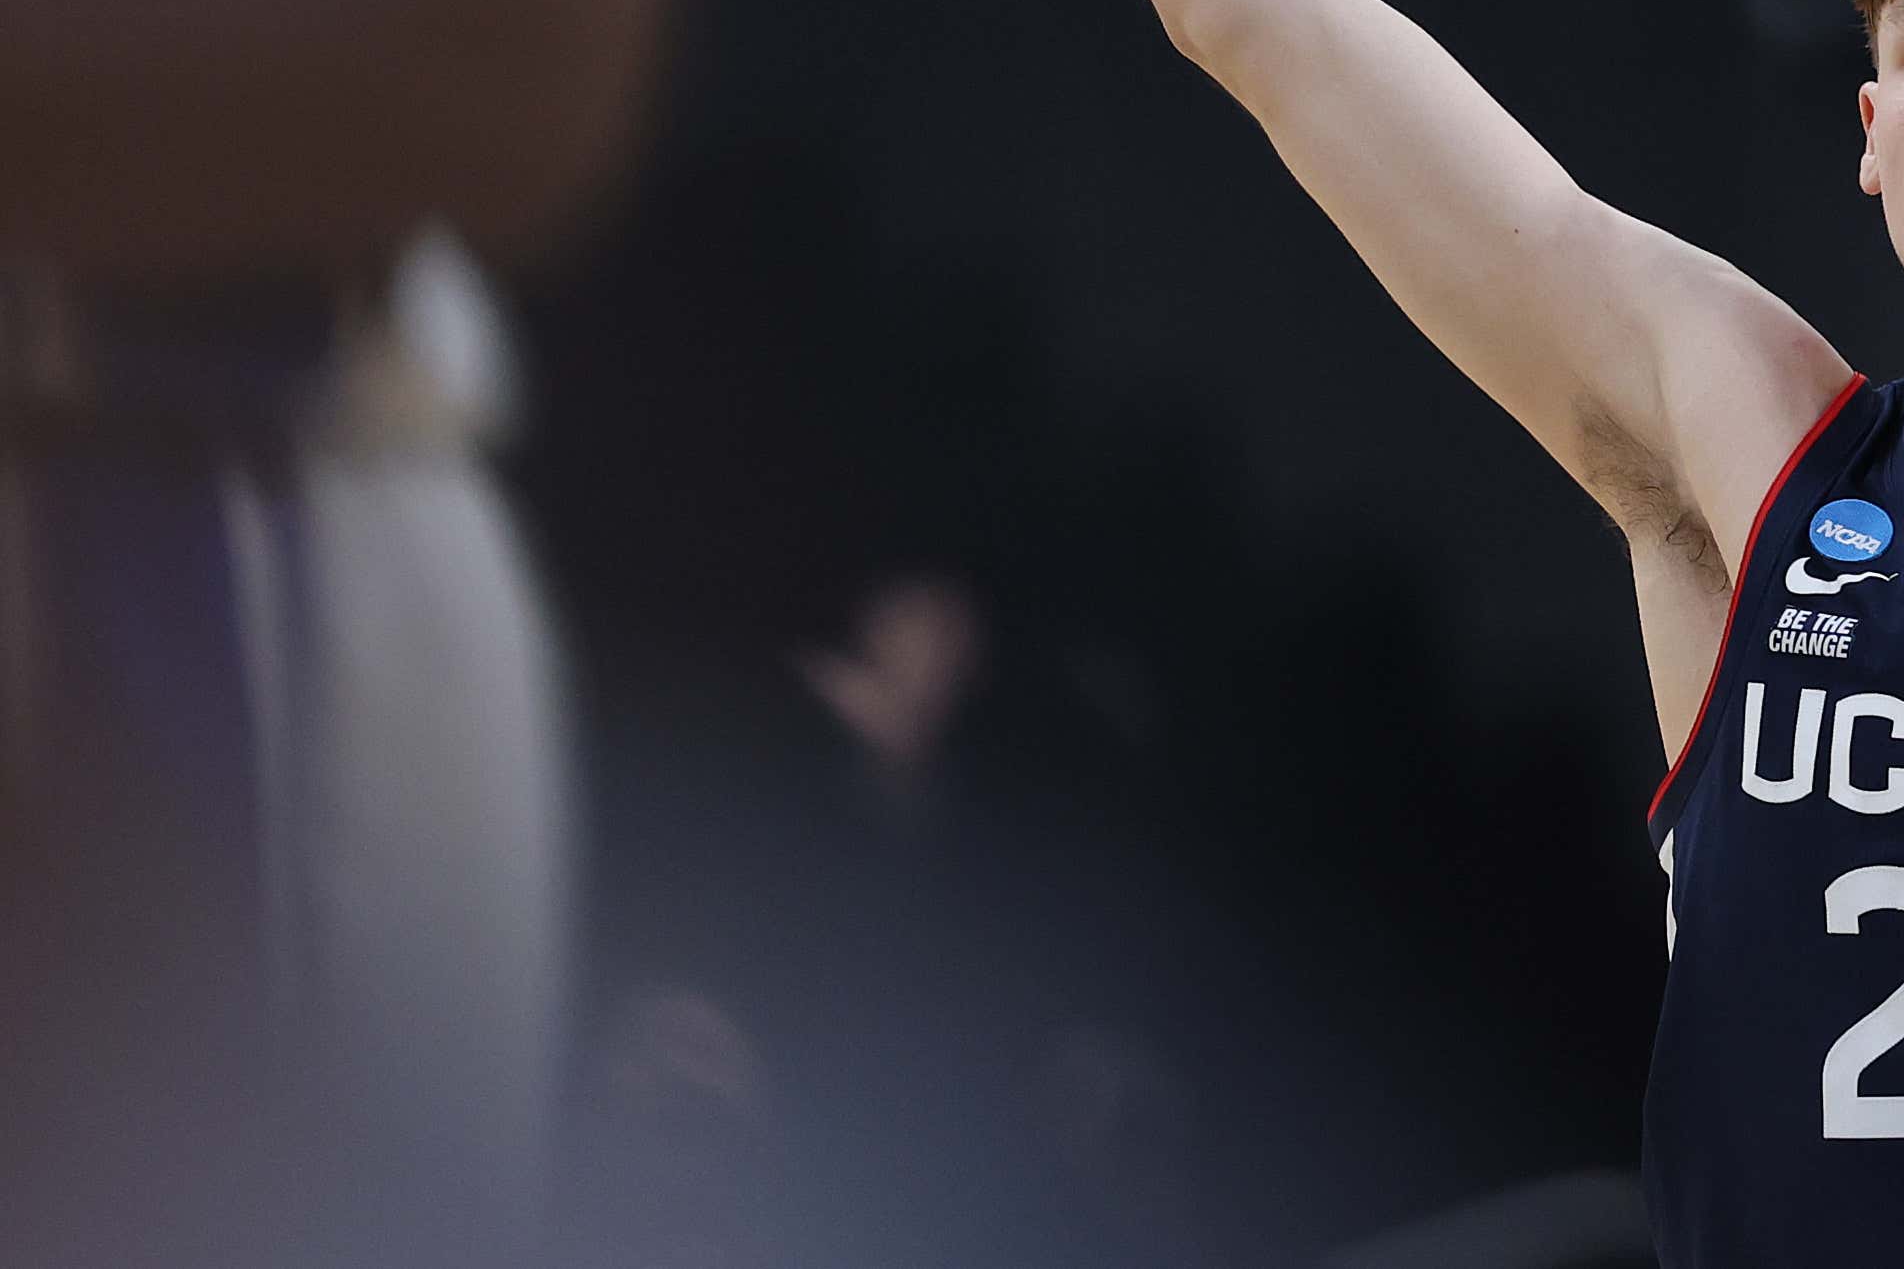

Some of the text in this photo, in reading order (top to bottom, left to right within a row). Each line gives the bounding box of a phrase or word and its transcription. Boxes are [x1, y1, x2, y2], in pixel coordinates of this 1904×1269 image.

[1816, 519, 1882, 555] NCAA
[1777, 608, 1859, 635] BE THE
[1768, 629, 1852, 658] CHANGE
